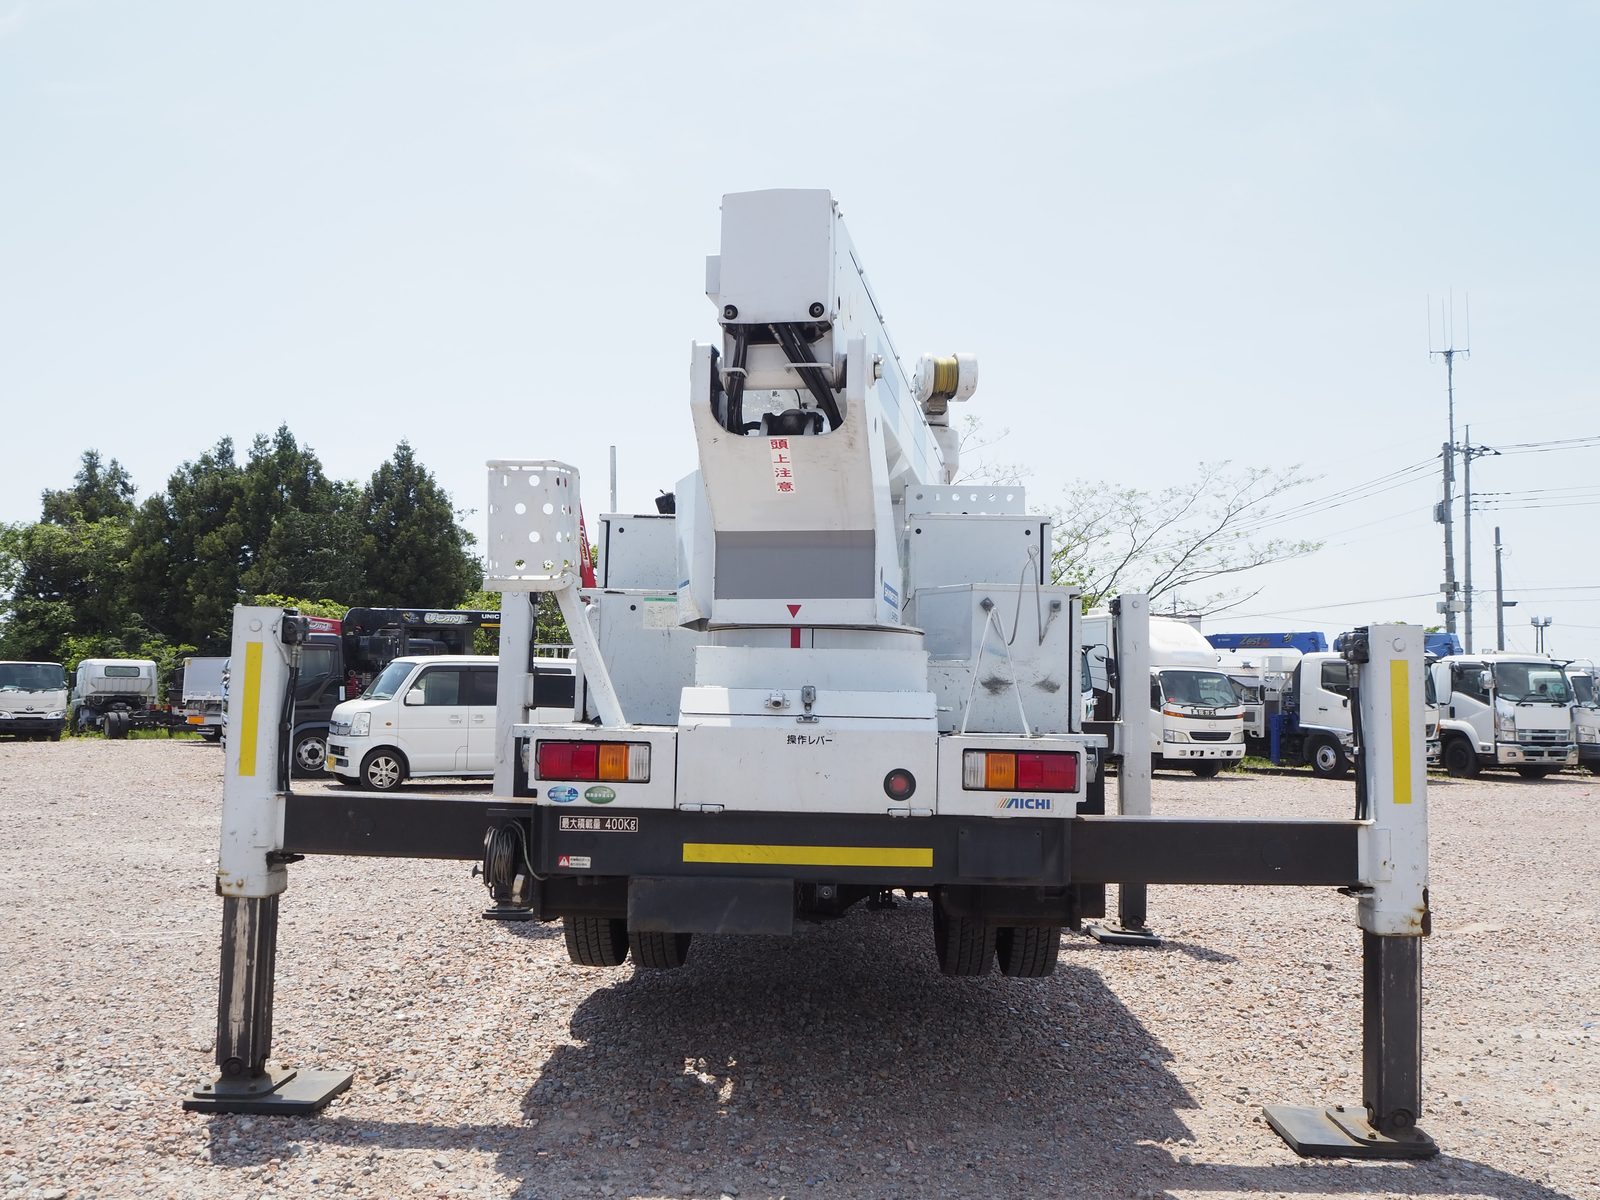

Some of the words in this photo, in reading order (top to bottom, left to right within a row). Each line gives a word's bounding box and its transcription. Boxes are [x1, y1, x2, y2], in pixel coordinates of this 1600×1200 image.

[770, 438, 794, 492] 頭上注意
[786, 734, 833, 745] 操作レバー
[1006, 798, 1051, 809] AICHI
[561, 817, 601, 830] 最大積載量
[605, 818, 636, 831] 400Kg
